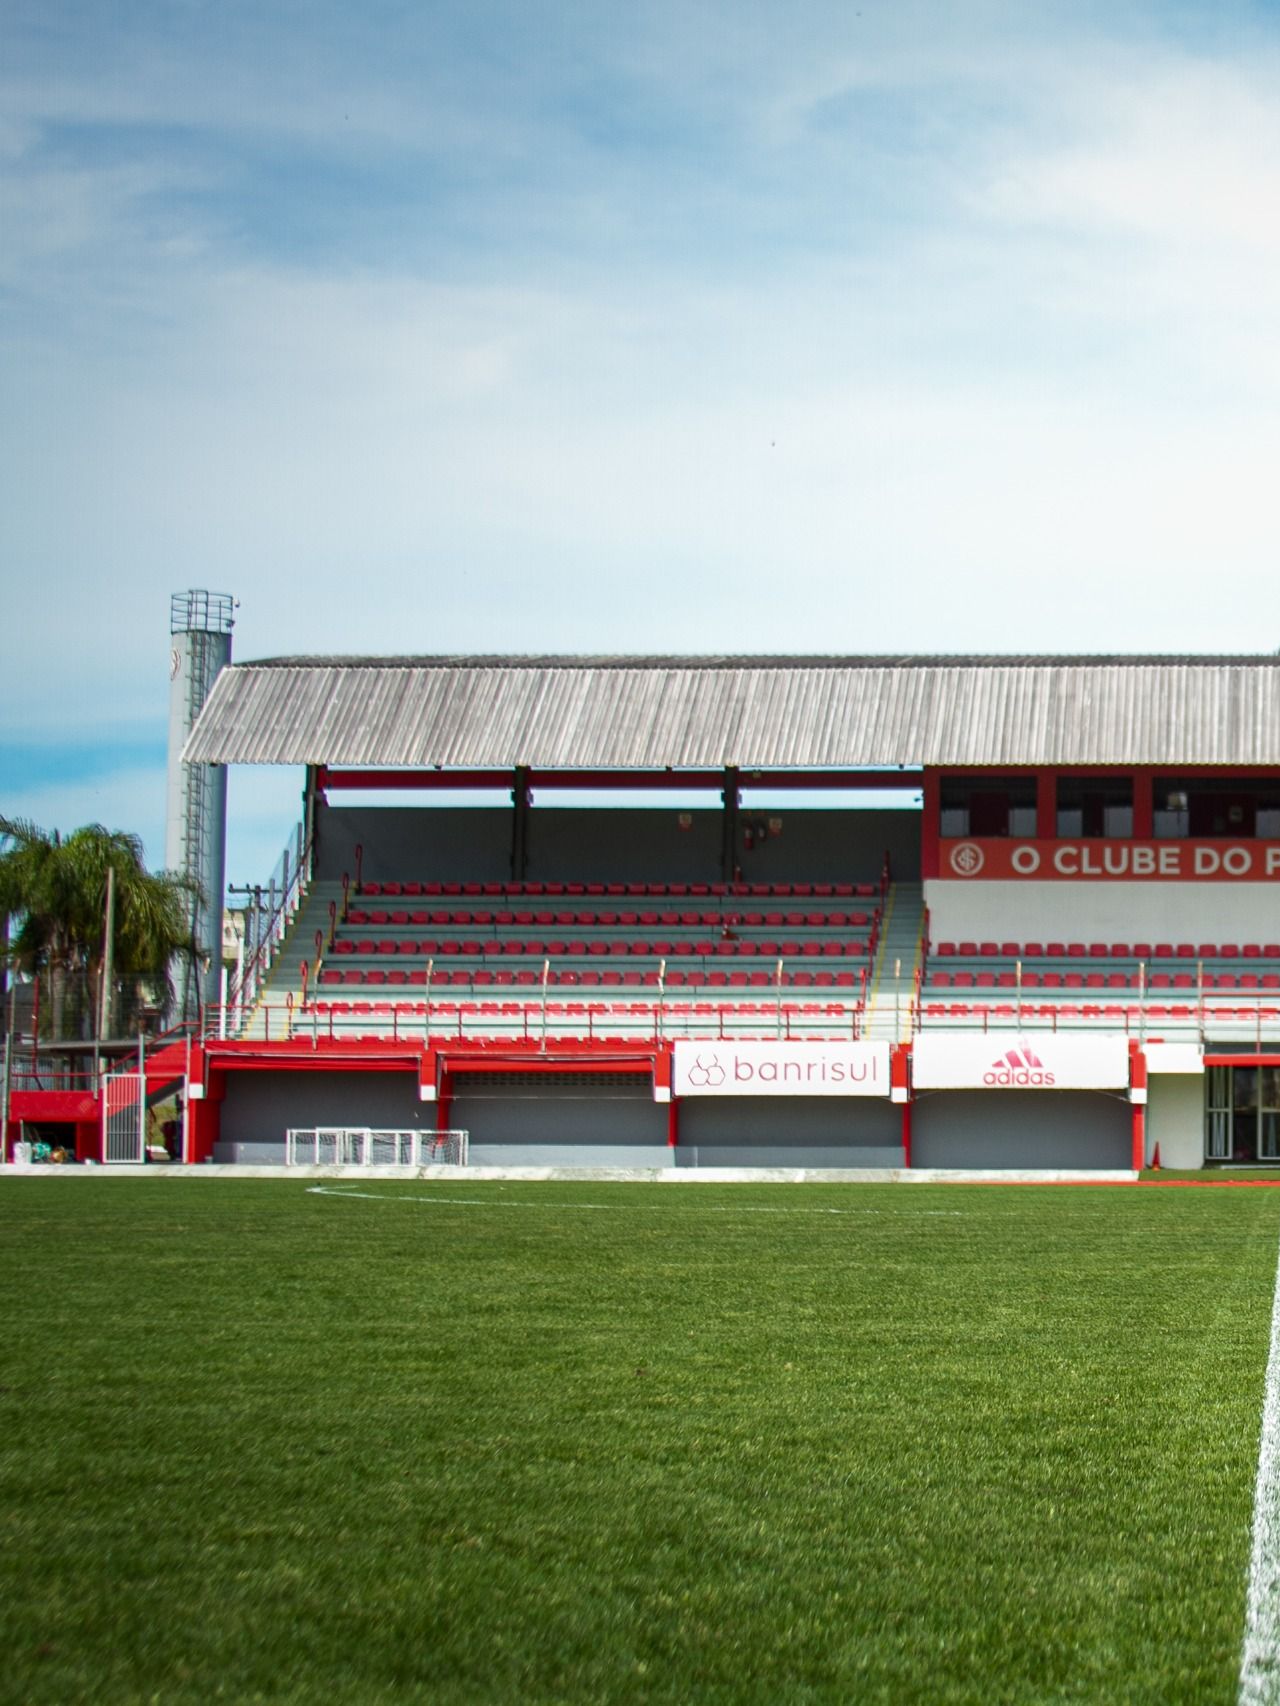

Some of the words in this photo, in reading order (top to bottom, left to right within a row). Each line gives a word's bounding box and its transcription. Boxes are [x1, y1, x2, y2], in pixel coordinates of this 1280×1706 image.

[1011, 846, 1041, 875] O
[1054, 846, 1181, 875] CLUBE
[1194, 847, 1252, 876] DO
[734, 1055, 877, 1082] banrisul
[983, 1068, 1055, 1085] adidas
